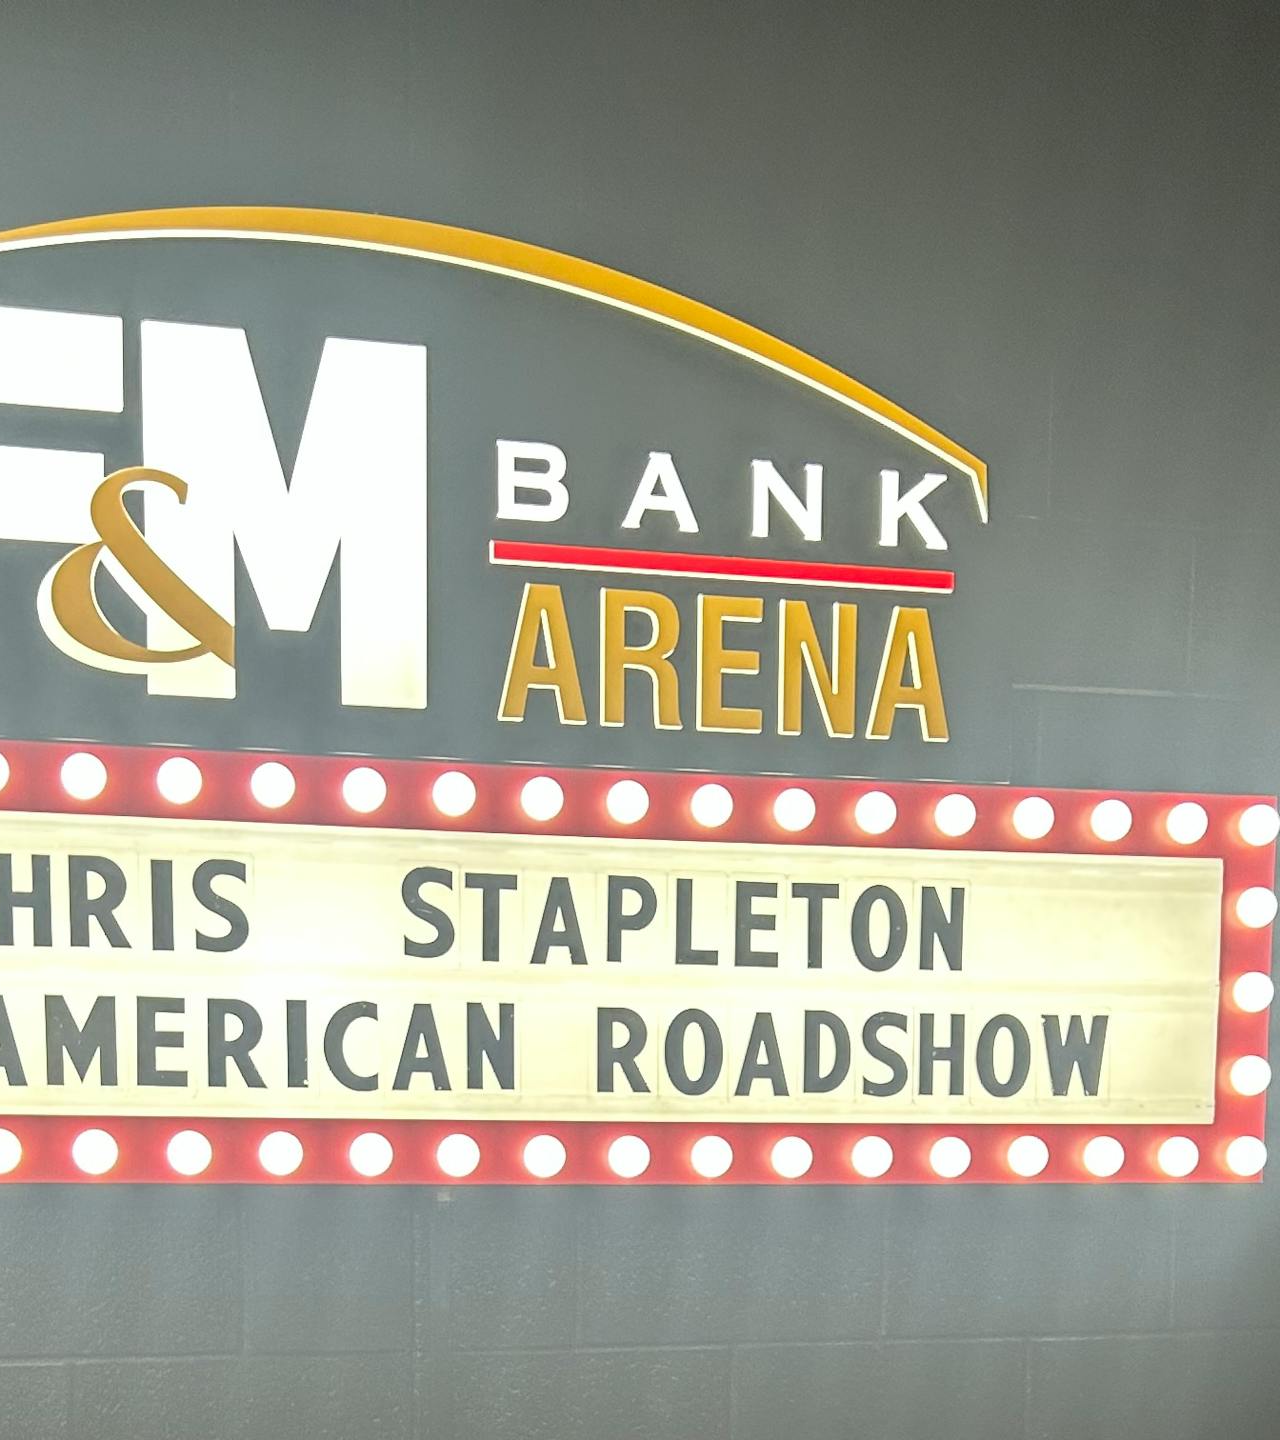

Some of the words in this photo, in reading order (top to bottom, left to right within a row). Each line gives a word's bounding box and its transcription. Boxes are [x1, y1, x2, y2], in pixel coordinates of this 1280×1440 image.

[495, 438, 949, 551] BANK
[497, 580, 951, 743] ARENA
[400, 866, 966, 972] STAPLETON
[595, 1005, 1110, 1098] ROADSHOW
